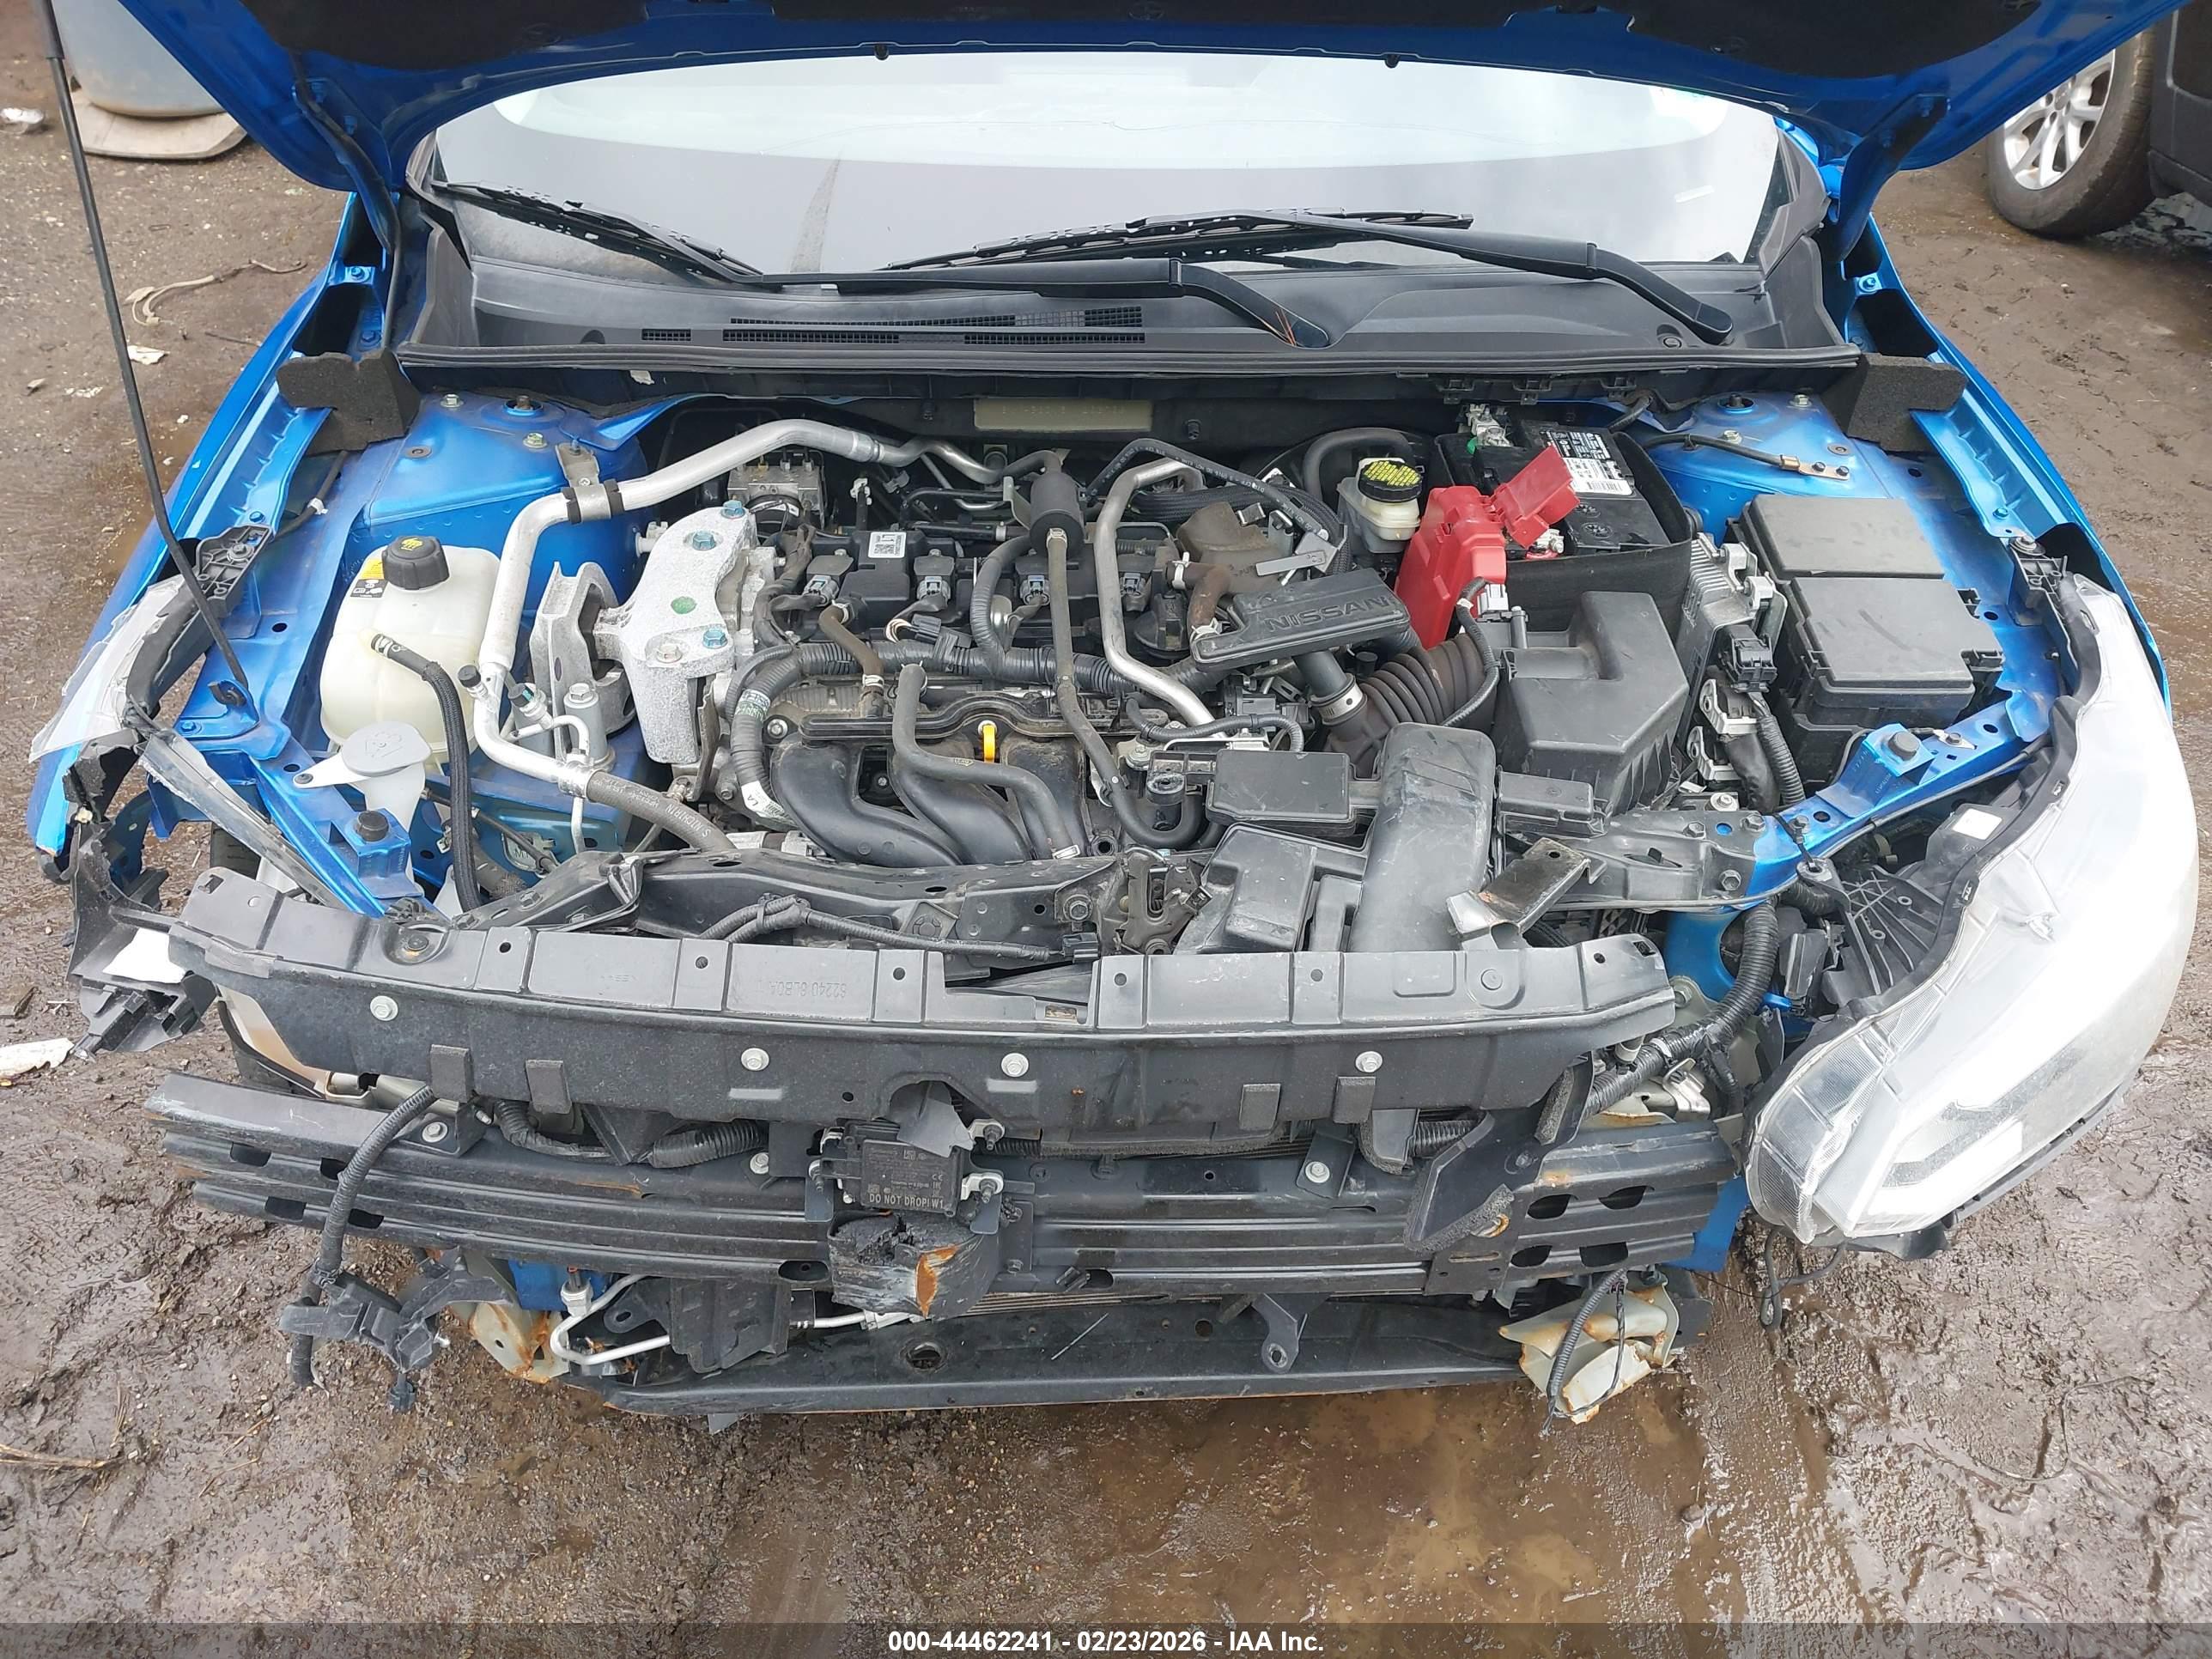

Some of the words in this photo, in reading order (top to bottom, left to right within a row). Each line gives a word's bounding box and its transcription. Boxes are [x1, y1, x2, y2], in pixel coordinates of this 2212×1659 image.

[1263, 596, 1392, 632] NISSAN
[665, 803, 703, 831] NICHIRIN
[869, 1194, 881, 1204] DO
[884, 1194, 902, 1205] NOT
